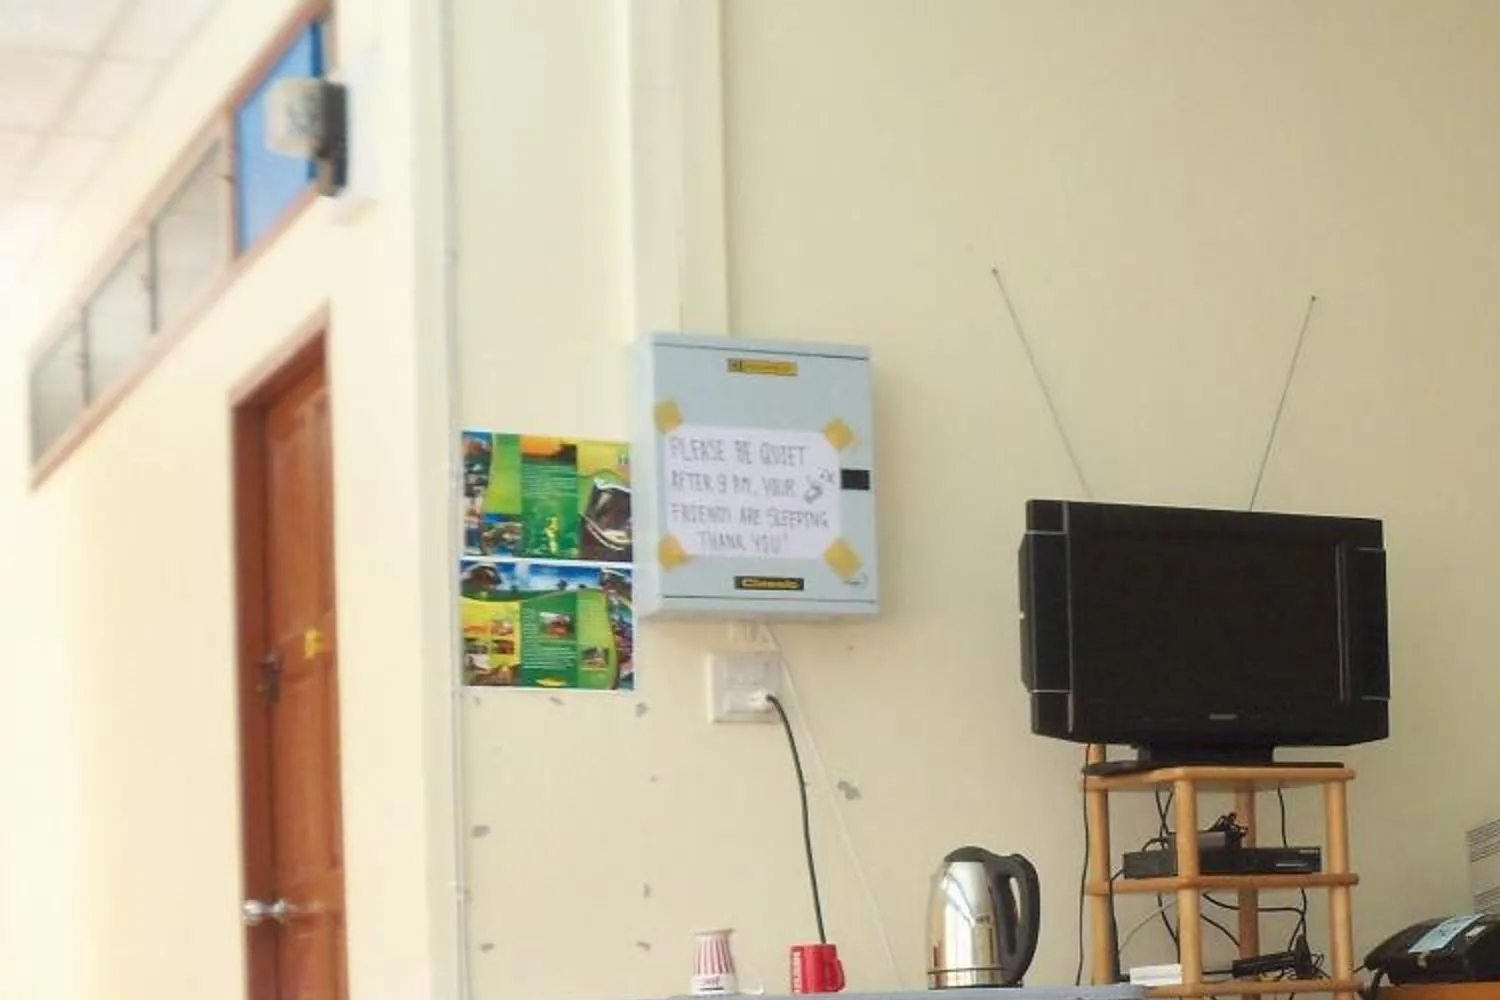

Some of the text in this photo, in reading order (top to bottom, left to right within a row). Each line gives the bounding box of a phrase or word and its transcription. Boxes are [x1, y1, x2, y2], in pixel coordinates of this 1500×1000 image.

[669, 437, 807, 466] PLEASE BE QUIET
[671, 470, 714, 494] AFTER
[717, 473, 728, 494] 9
[761, 477, 796, 497] YOUR
[671, 503, 828, 529] FRIENDS ARE SLEEPING
[697, 530, 747, 550] THANK
